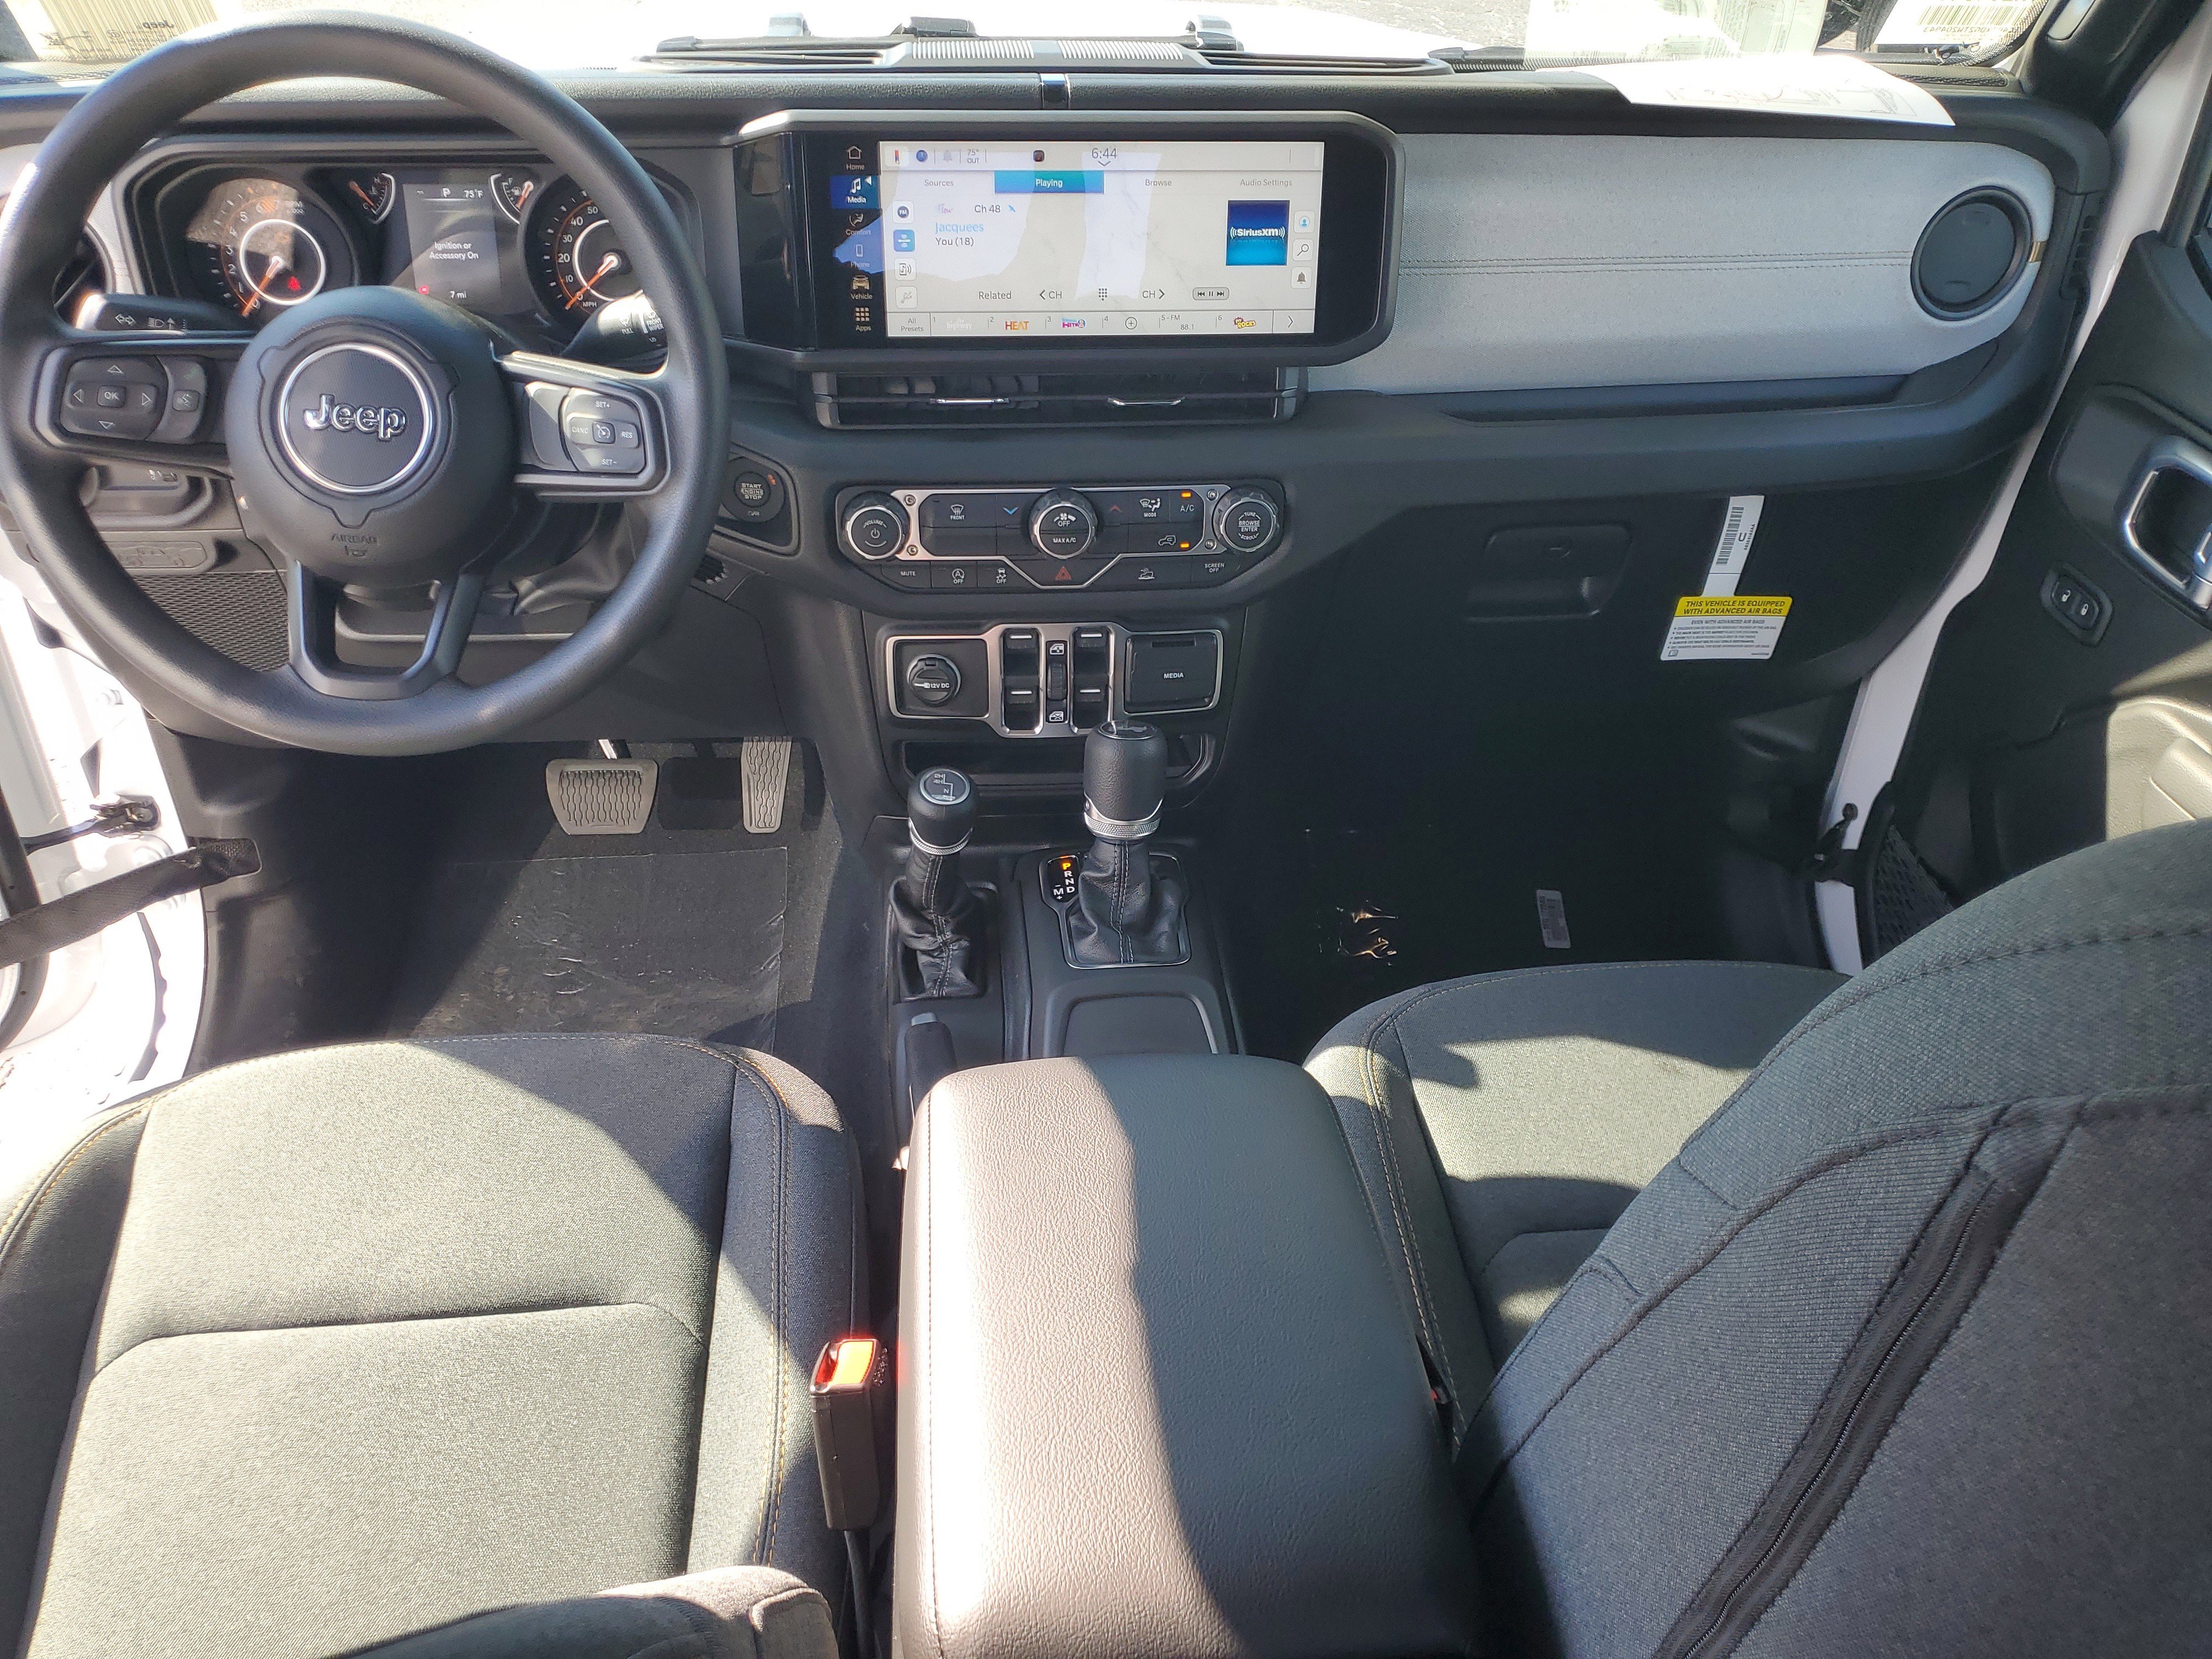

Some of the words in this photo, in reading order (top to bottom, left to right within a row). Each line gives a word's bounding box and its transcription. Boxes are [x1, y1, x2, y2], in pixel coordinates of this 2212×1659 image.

[1091, 148, 1118, 159] 6:44
[1035, 179, 1063, 188] Playing
[1263, 179, 1293, 188] Settings
[442, 188, 452, 198] P
[587, 206, 599, 215] 50
[974, 205, 987, 213] Ch
[240, 211, 249, 222] 5
[571, 216, 584, 226] 40
[935, 222, 984, 235] Jacquees
[562, 234, 573, 243] 30
[935, 237, 953, 246] You
[955, 236, 974, 247] (18)
[225, 244, 233, 256] 3
[434, 241, 462, 251] Ignition
[429, 251, 466, 261] Accessory
[467, 251, 479, 259] On
[557, 253, 571, 263] 20
[228, 263, 236, 274] 2
[565, 274, 574, 283] 10
[238, 281, 244, 294] 1
[450, 290, 456, 298] 7
[456, 291, 467, 299] mi
[978, 291, 1012, 300] Related
[1048, 291, 1062, 300] CH
[1142, 290, 1156, 298] CH
[1005, 321, 1029, 330] HEAT
[104, 391, 120, 401] OK
[595, 400, 611, 408] SET+
[303, 393, 408, 442] Jeep
[1180, 504, 1194, 512] A/C
[1053, 888, 1064, 896] M
